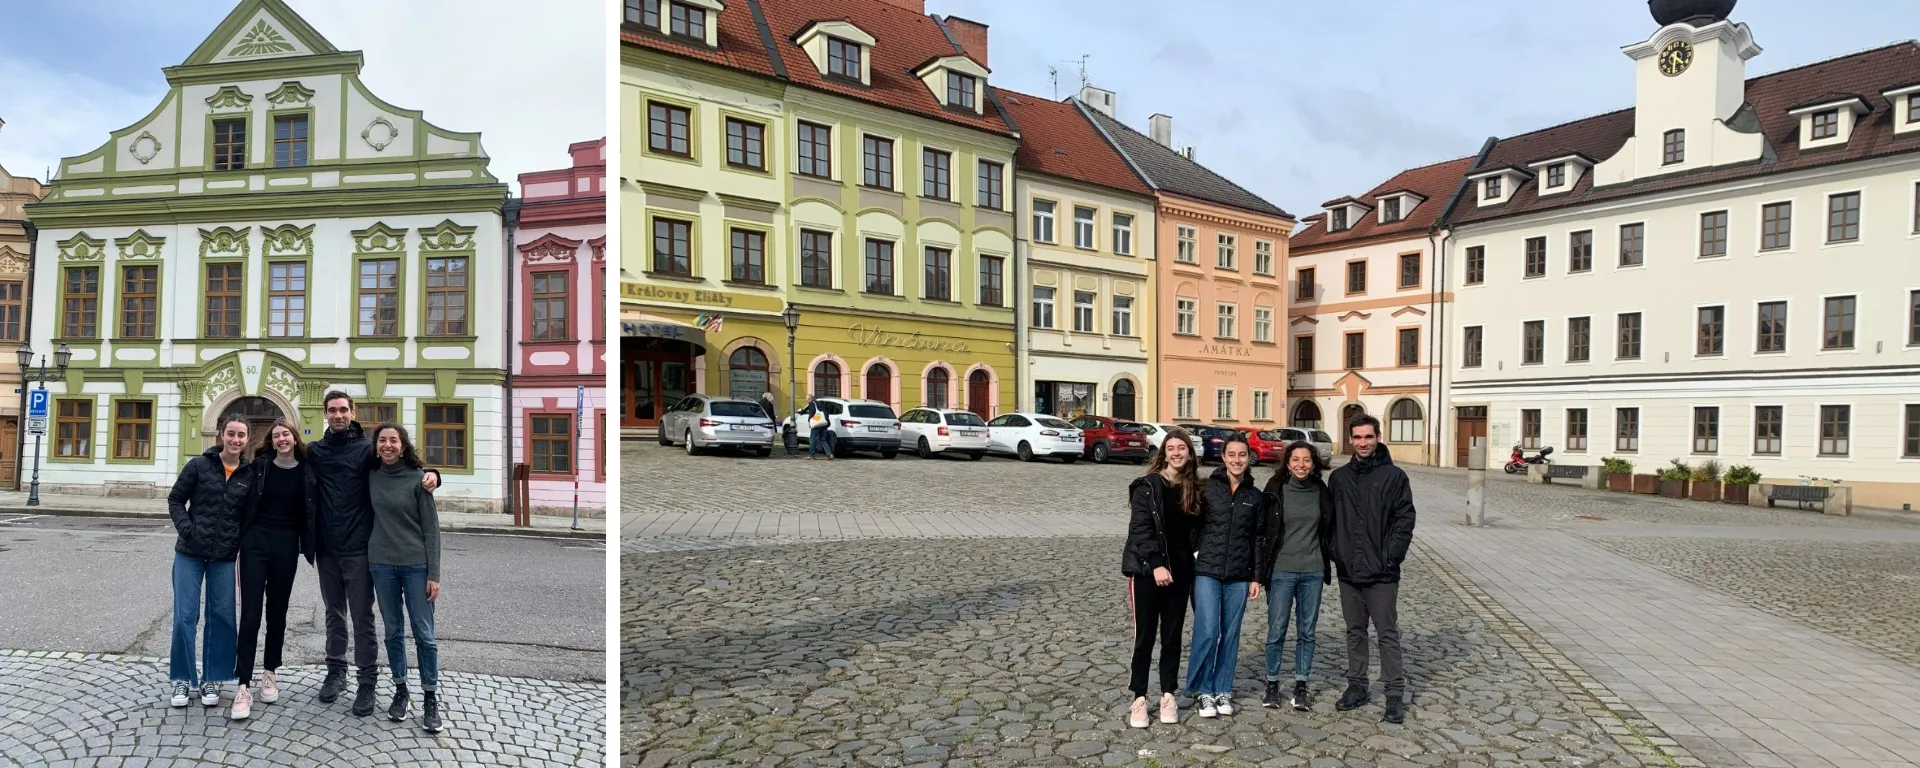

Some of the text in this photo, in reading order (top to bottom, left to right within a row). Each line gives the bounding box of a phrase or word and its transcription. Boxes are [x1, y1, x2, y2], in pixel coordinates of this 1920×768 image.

[623, 322, 684, 339] HOTEL
[848, 322, 971, 353] Vinárna
[33, 393, 45, 408] P
